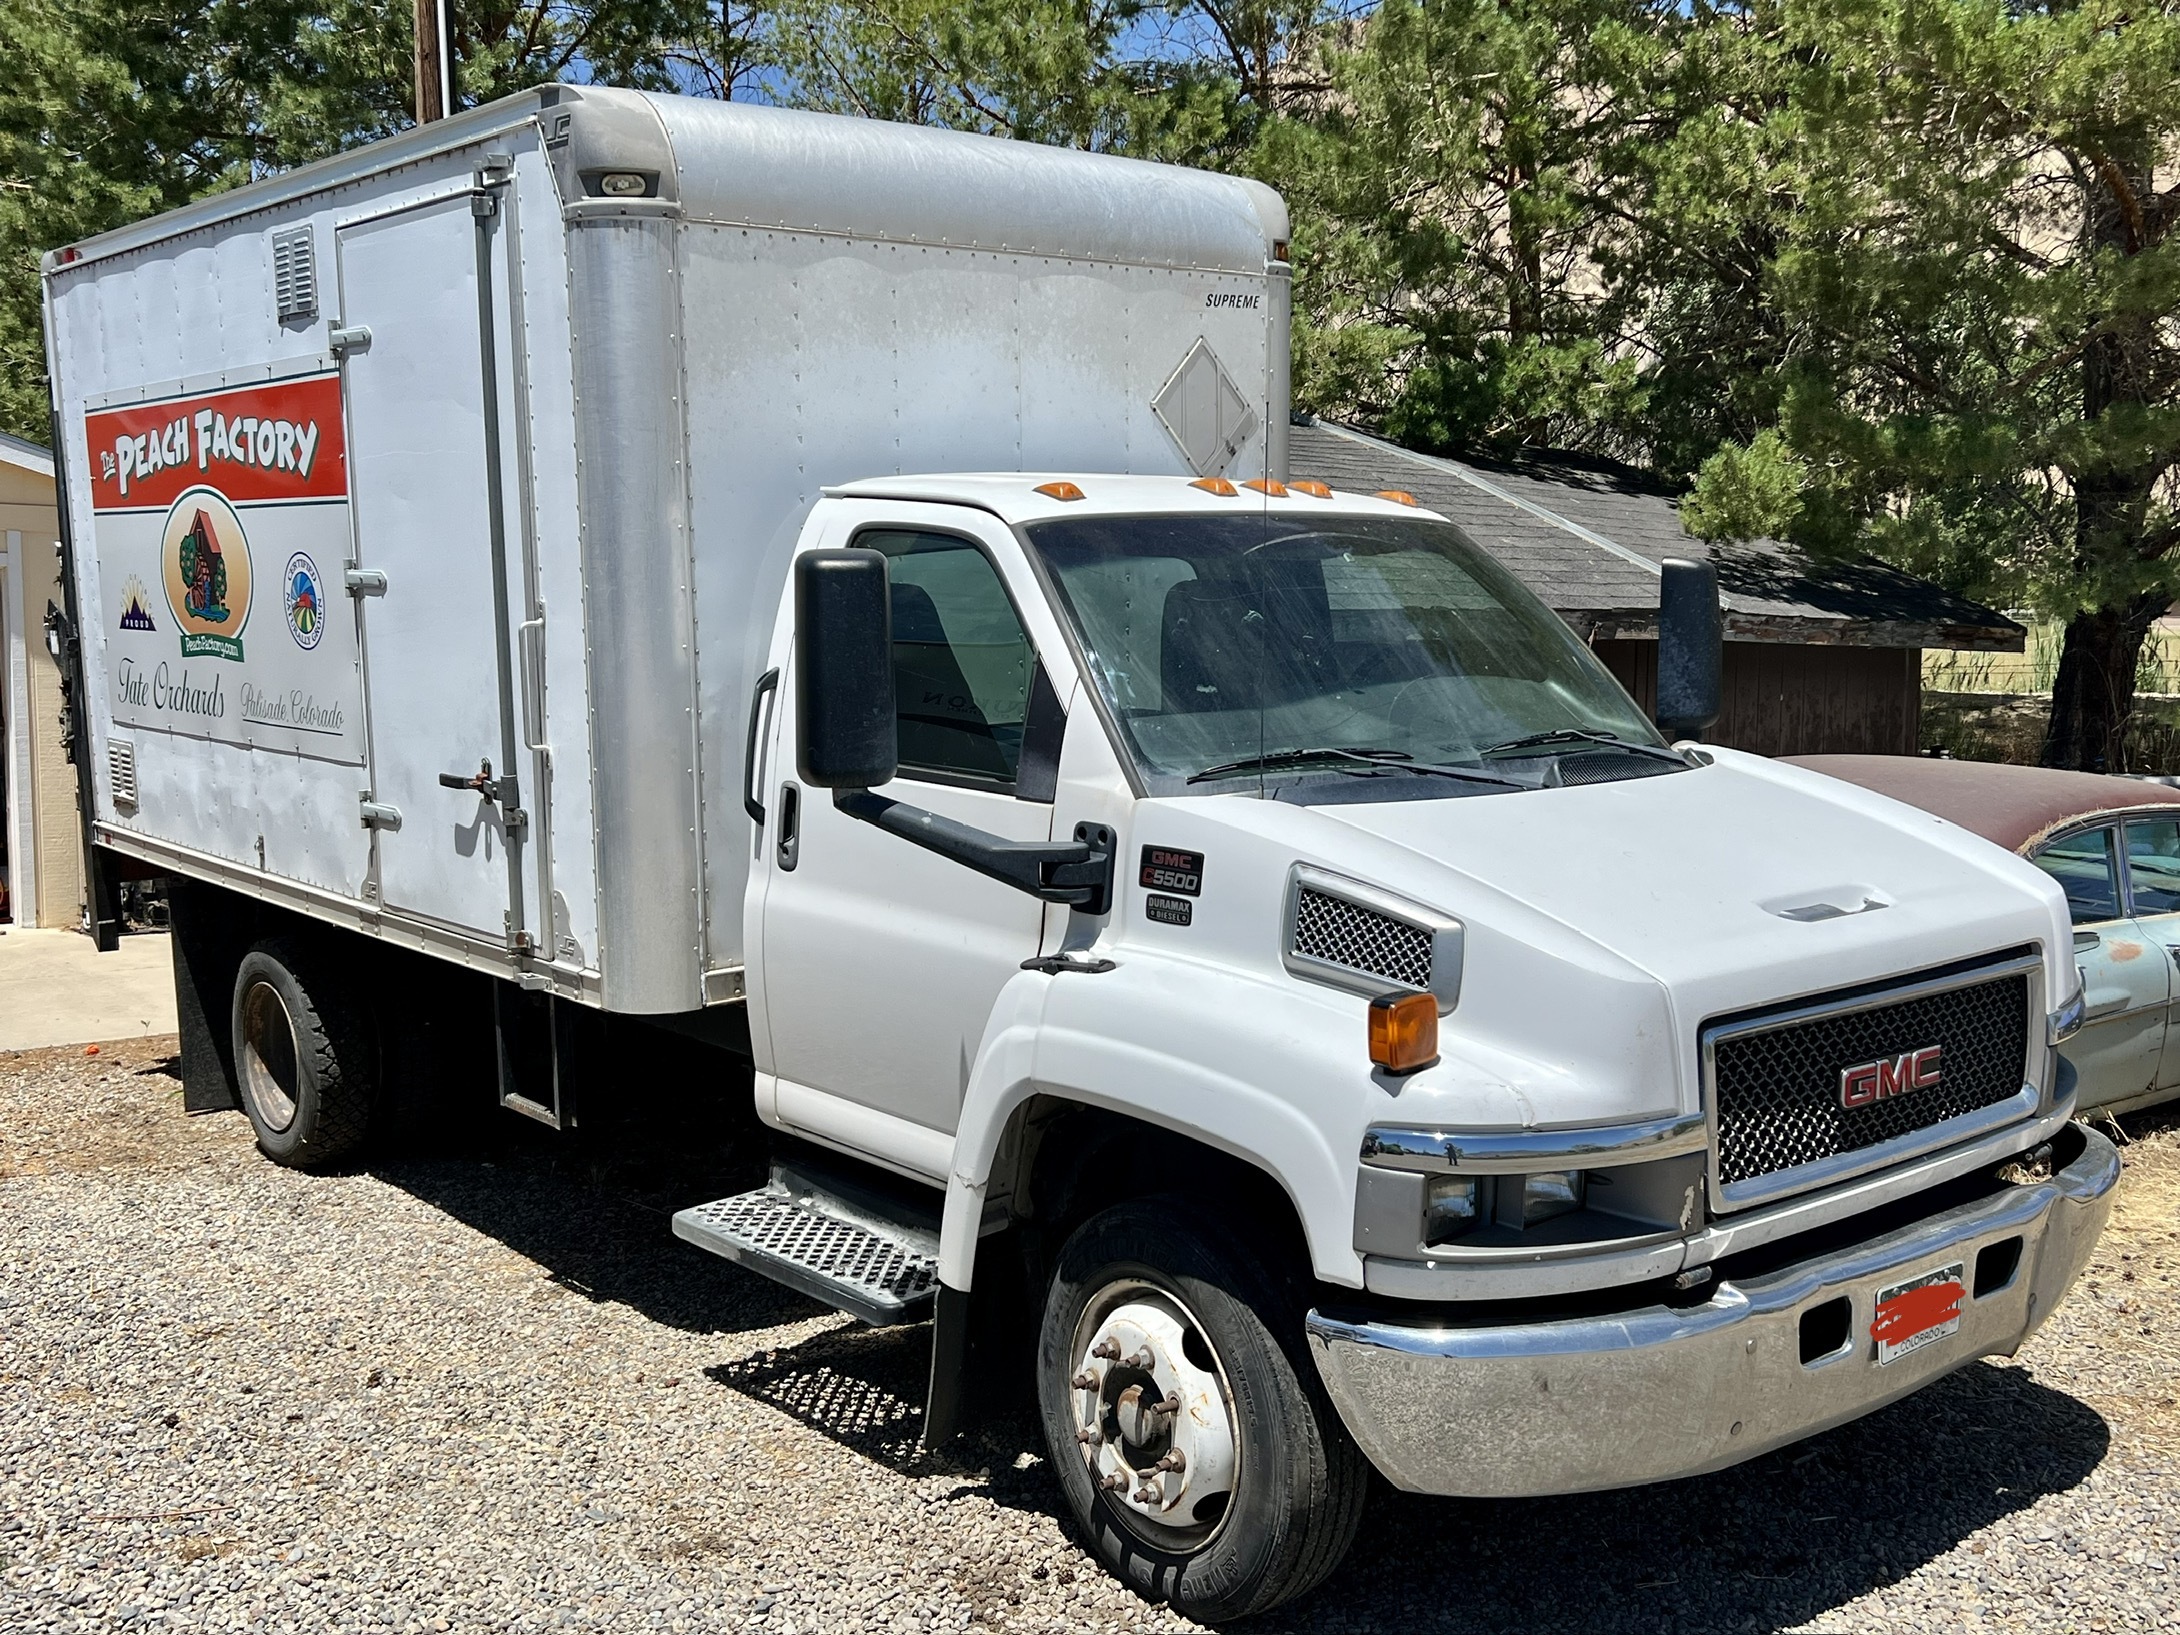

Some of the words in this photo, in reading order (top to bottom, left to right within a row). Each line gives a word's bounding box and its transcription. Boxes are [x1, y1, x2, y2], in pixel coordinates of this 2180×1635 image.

[1205, 293, 1260, 309] SUPREME
[101, 450, 116, 470] The
[116, 416, 191, 495] PEACH
[195, 408, 318, 479] FACTORY
[288, 559, 317, 581] CERTIFIED
[118, 658, 150, 706] Tate
[153, 661, 224, 718] Orchards
[290, 690, 345, 730] Colorado
[1151, 850, 1192, 869] GMC
[1142, 867, 1198, 891] C5500
[1148, 897, 1190, 913] DURAMAX
[1156, 911, 1181, 922] DIESEL
[1841, 1045, 1941, 1109] GMC
[1900, 1327, 1940, 1352] COLORADO
